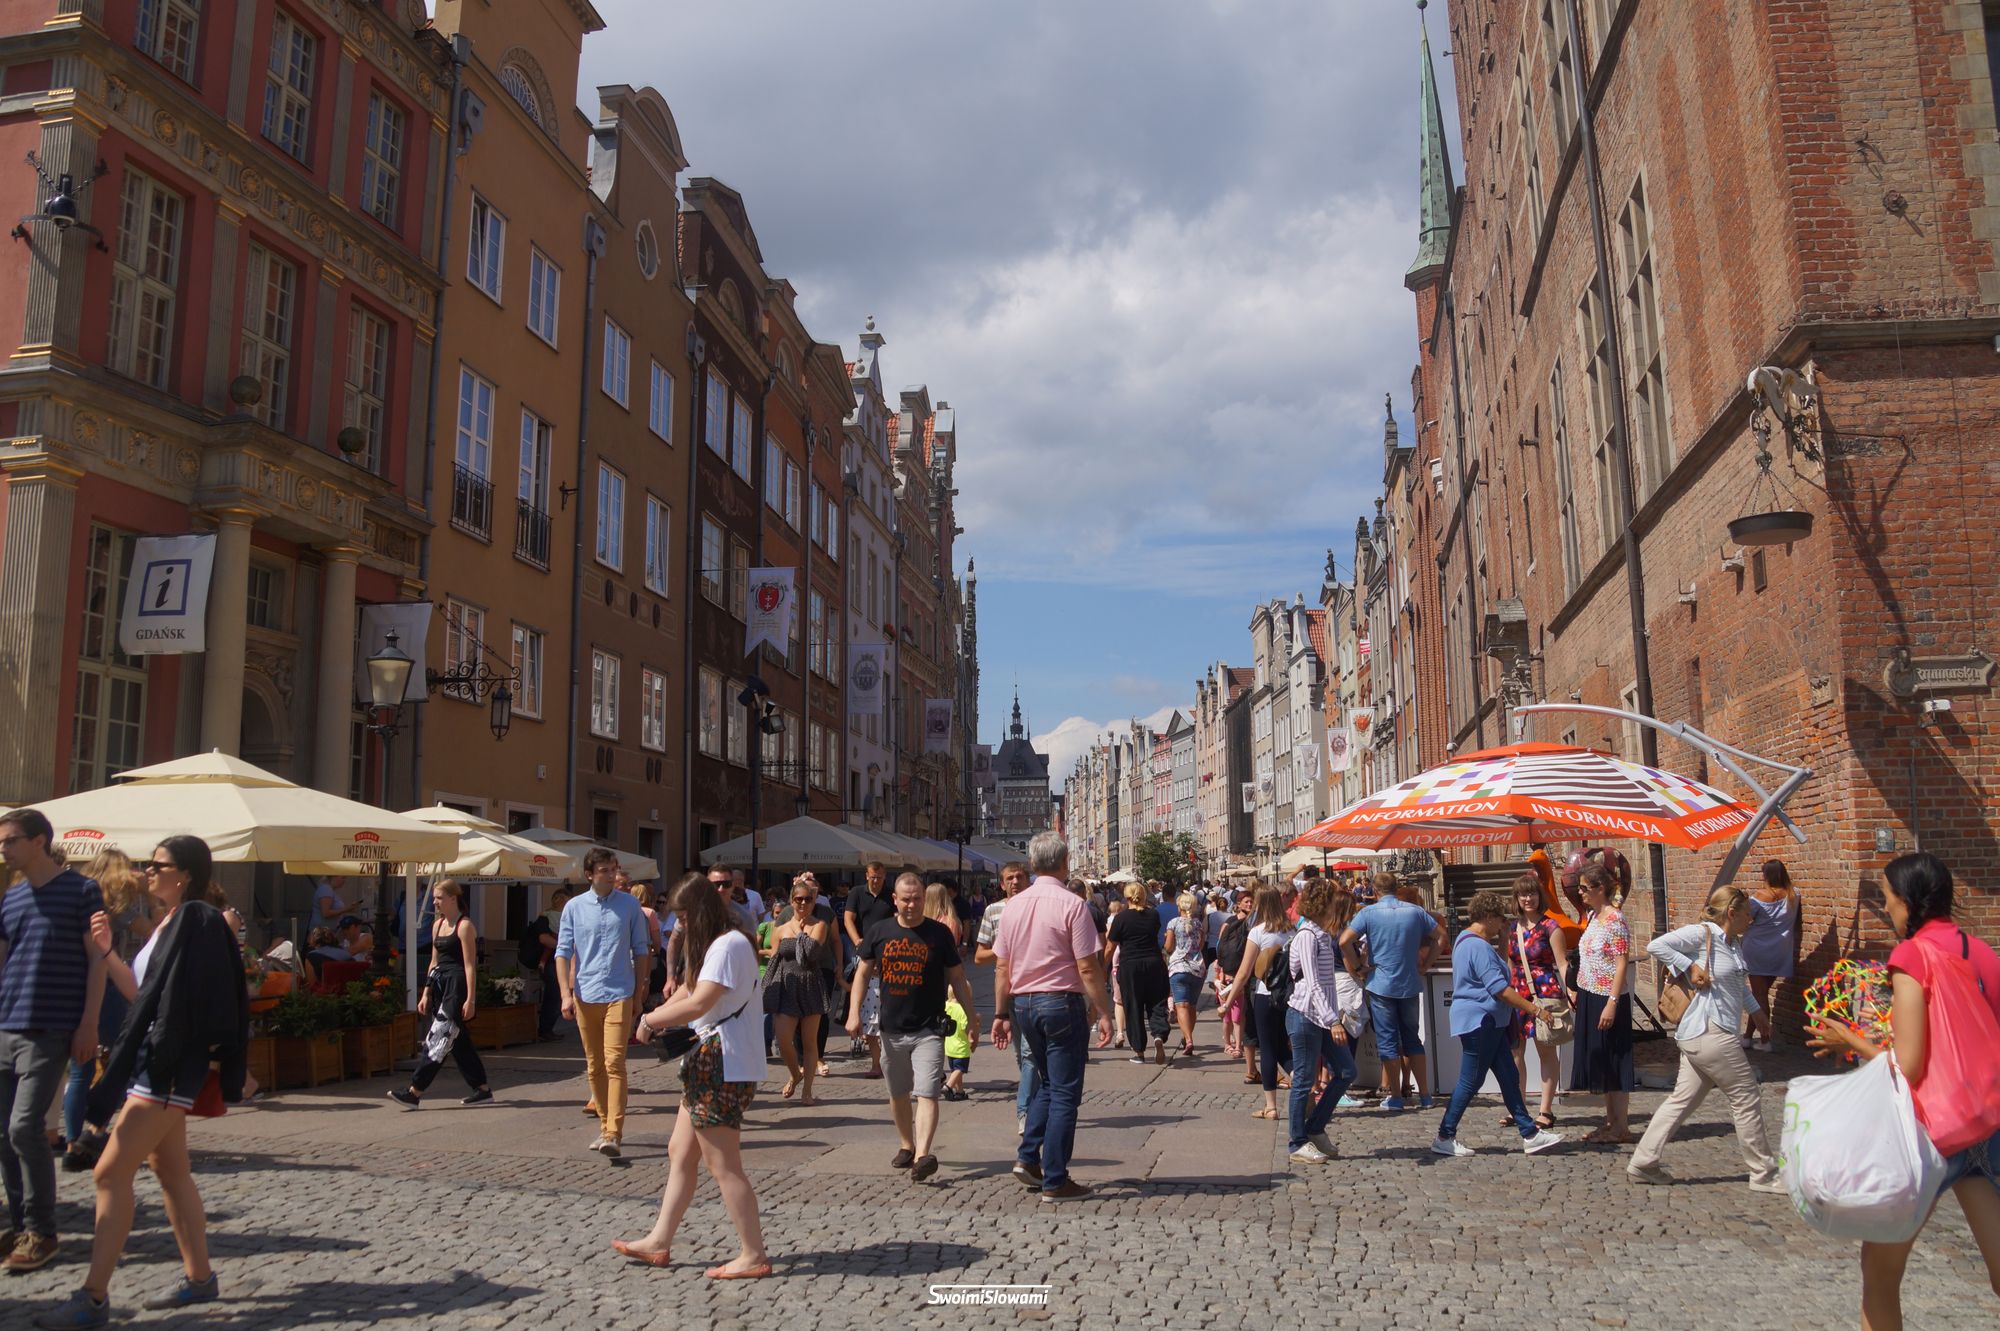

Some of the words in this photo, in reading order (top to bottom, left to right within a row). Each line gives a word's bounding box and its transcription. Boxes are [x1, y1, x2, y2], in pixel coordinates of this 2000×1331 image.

[136, 626, 185, 640] GDAŃSK
[1350, 801, 1500, 824] INFORMATION
[1531, 803, 1664, 837] INFORMACJA
[1684, 808, 1756, 839] INFORMATION
[342, 845, 390, 859] ZWIERZYNIEC
